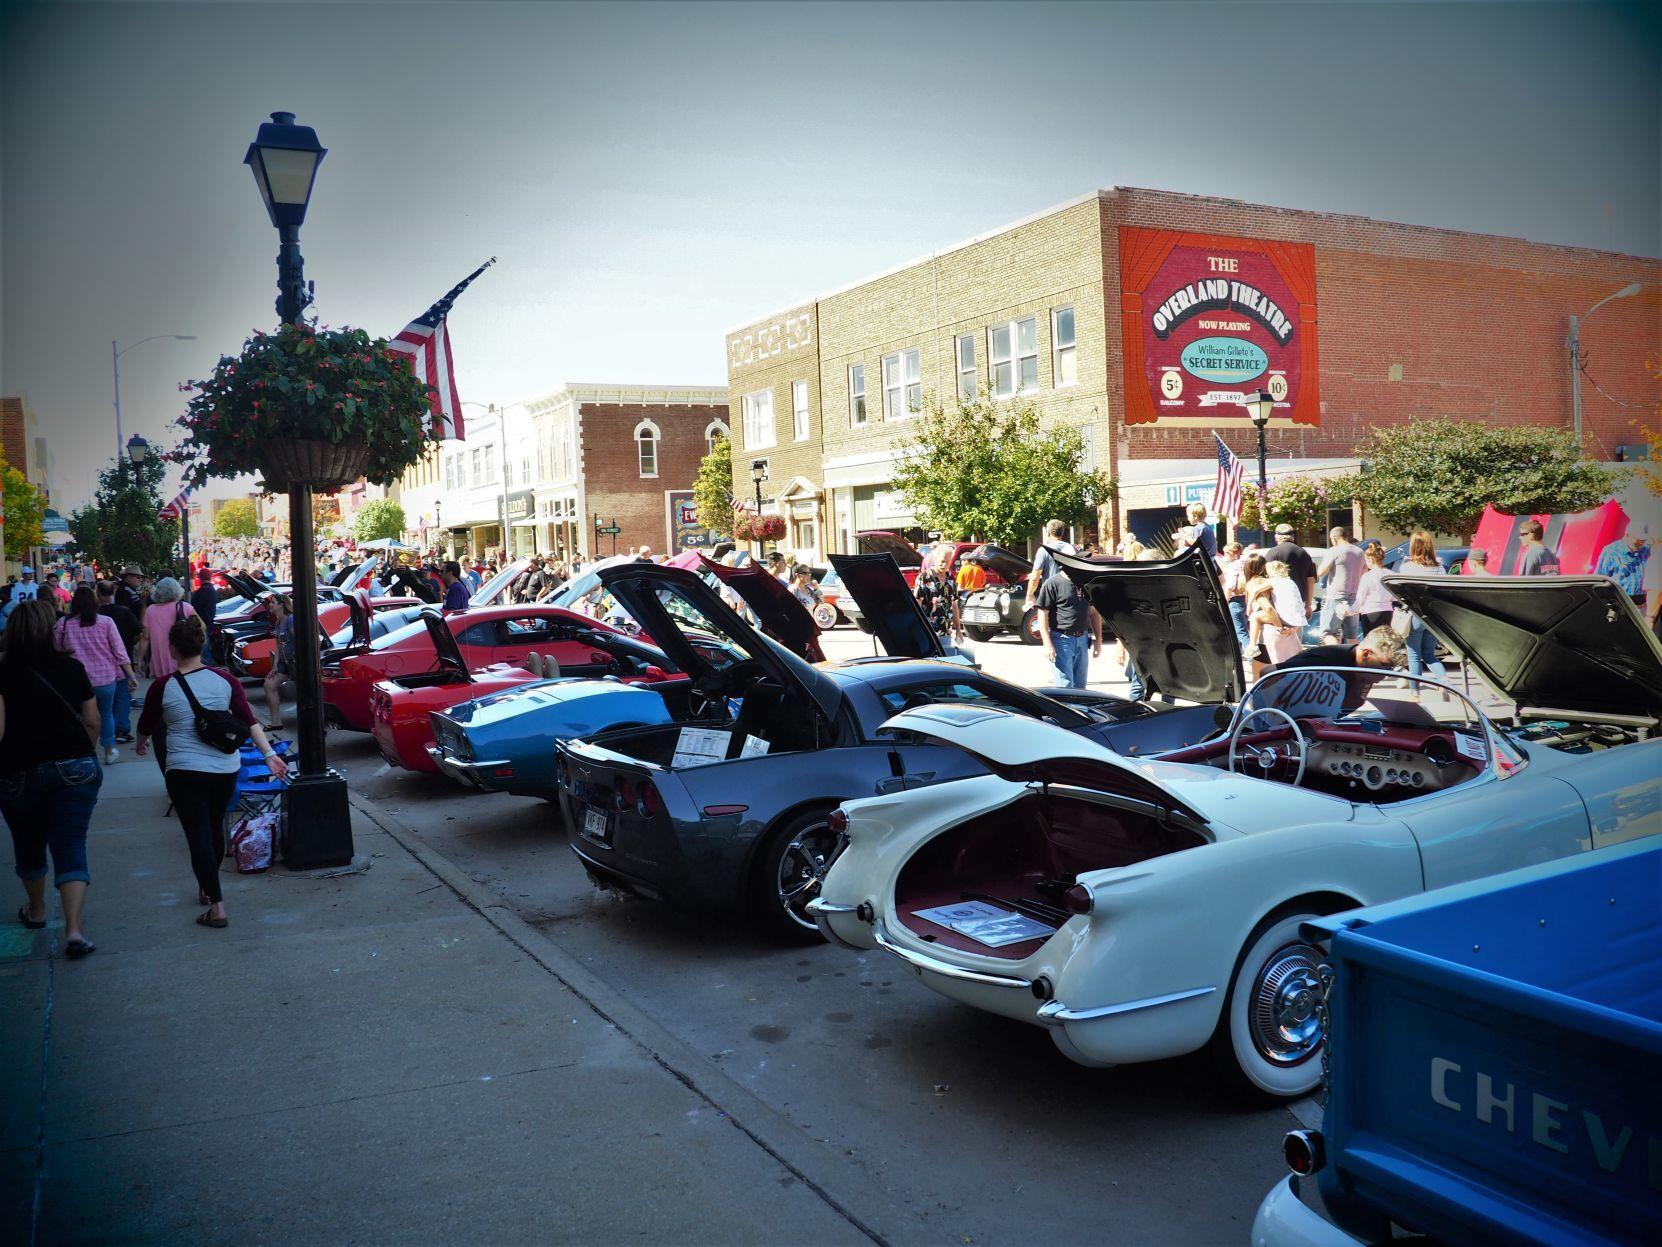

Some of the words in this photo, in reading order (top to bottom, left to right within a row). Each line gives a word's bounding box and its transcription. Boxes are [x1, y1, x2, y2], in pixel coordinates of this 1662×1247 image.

[1207, 256, 1239, 272] THE
[1153, 279, 1229, 331] OVERLAND
[1230, 281, 1293, 339] THEATRE
[1199, 320, 1218, 330] NOW
[1219, 321, 1251, 331] PLAYING
[1198, 345, 1225, 355] William
[1431, 1057, 1662, 1190] CHEV
